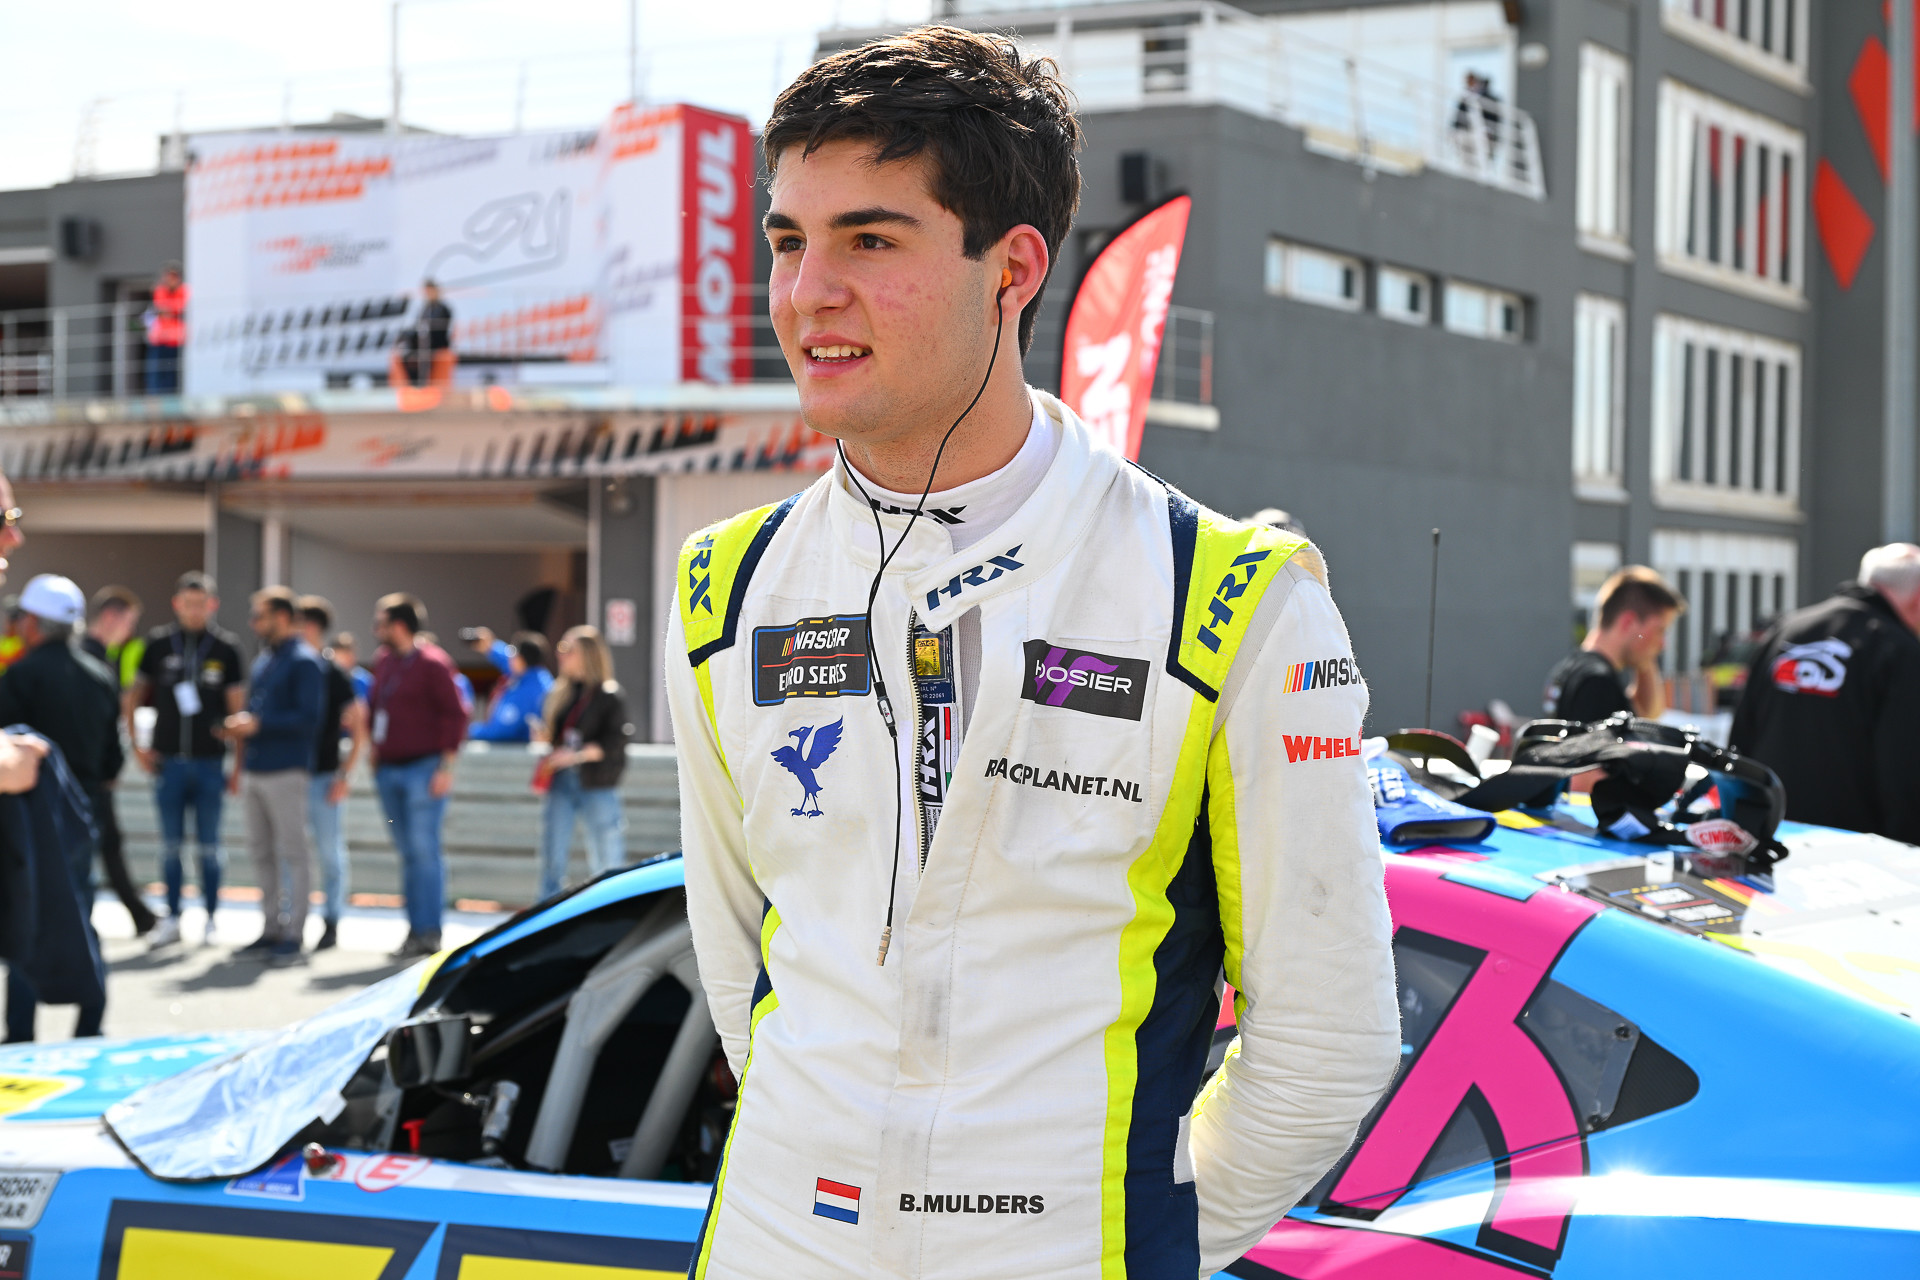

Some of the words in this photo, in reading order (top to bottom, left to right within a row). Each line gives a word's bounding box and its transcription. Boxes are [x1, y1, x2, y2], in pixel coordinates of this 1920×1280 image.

[697, 124, 736, 384] MOTUL
[926, 543, 1025, 611] HRX
[1197, 549, 1273, 654] HRX
[793, 627, 850, 651] NASCAR
[1310, 657, 1362, 691] NASC
[1282, 727, 1363, 764] WHEL
[984, 757, 1143, 803] RACPLANET.NL
[899, 1193, 1045, 1214] B.MULDERS
